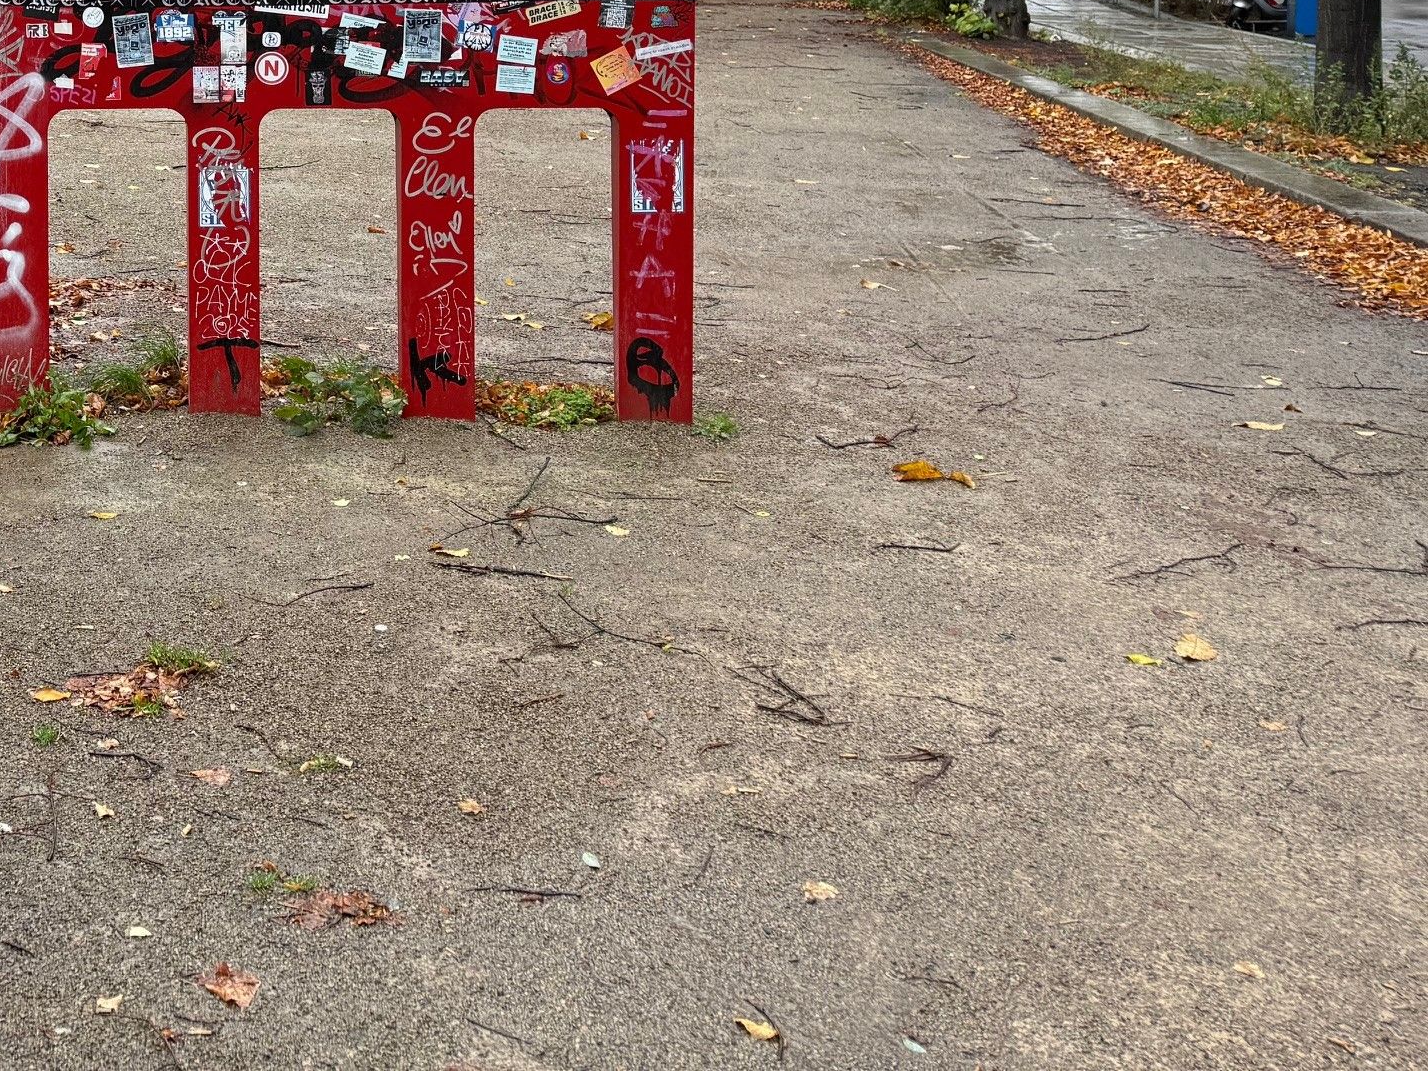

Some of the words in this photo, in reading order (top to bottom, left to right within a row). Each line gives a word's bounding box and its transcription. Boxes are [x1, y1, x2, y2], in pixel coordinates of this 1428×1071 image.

[529, 3, 557, 17] BRACE
[531, 10, 559, 23] BRACE
[159, 27, 192, 38] 1892
[264, 60, 279, 77] N
